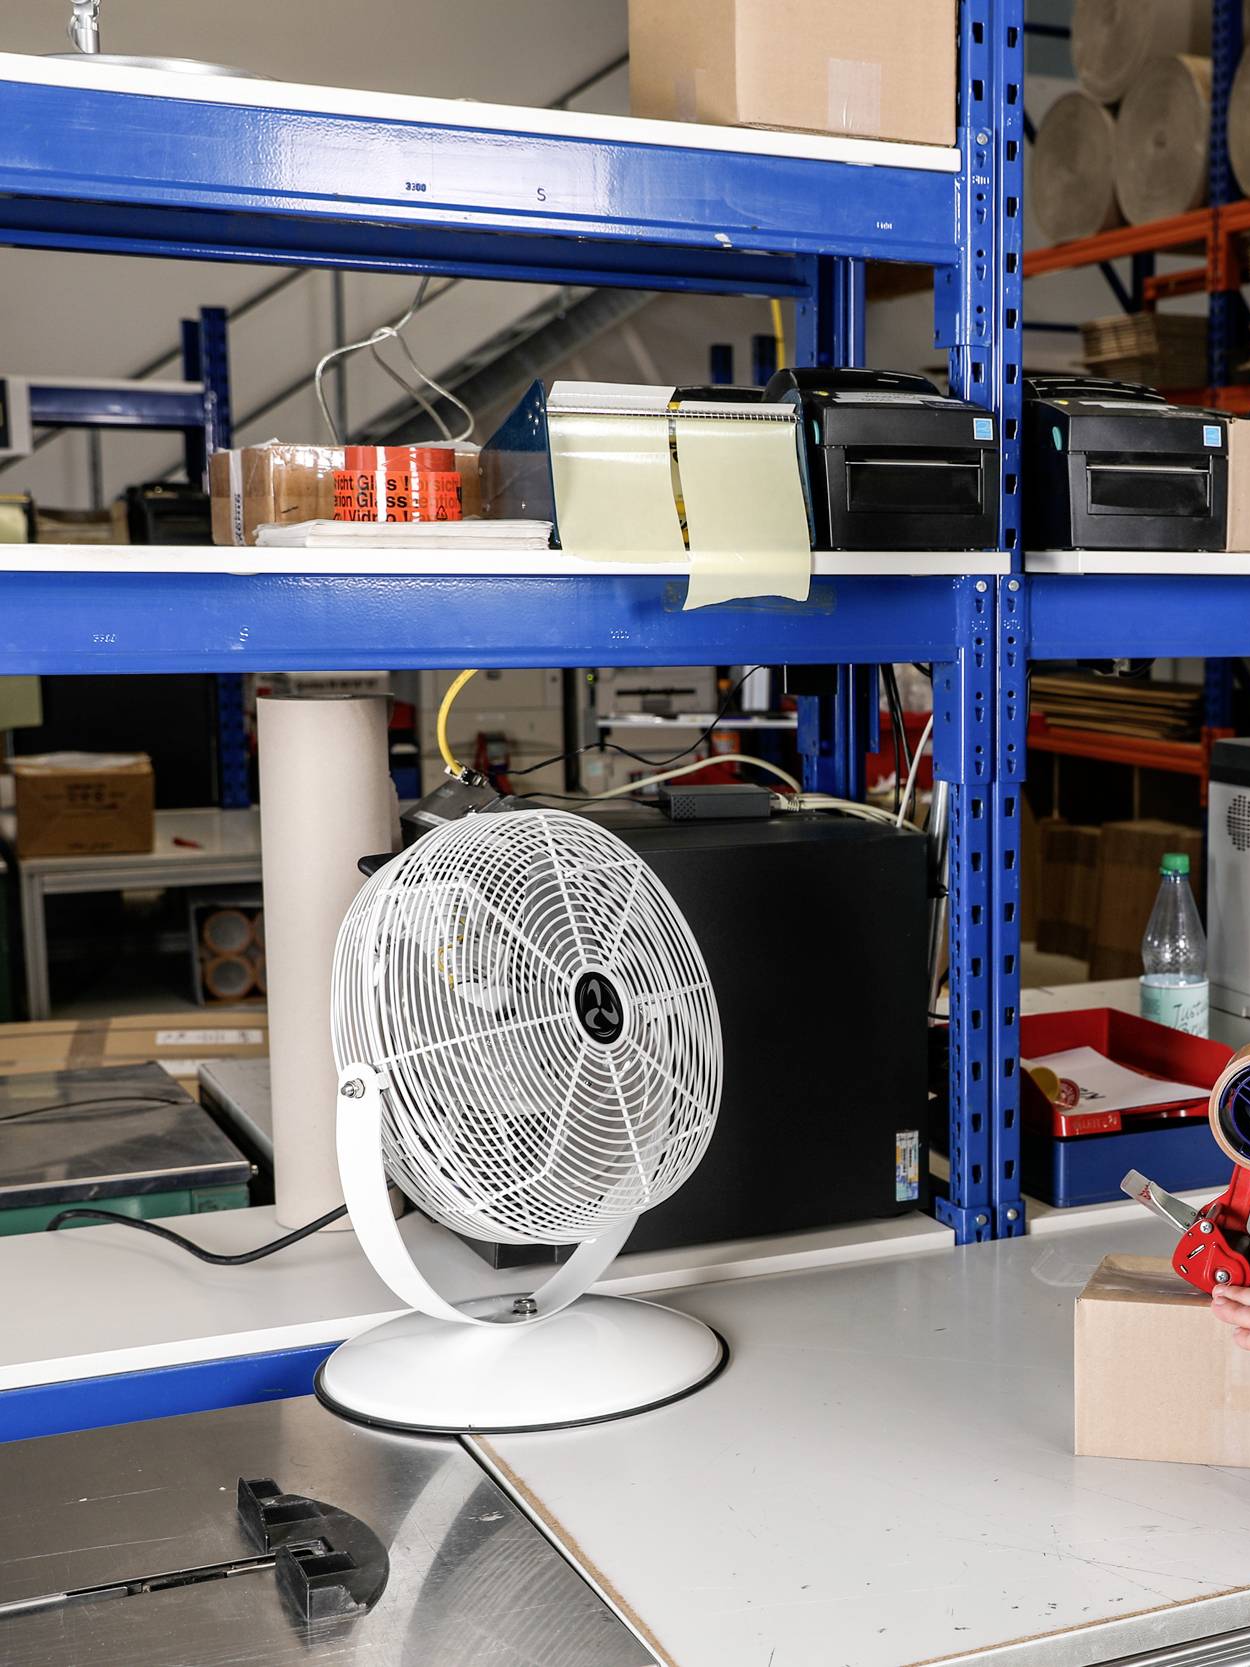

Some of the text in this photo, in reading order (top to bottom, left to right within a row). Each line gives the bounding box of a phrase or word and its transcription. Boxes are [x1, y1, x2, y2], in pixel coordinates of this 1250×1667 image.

[536, 187, 547, 202] S
[357, 474, 397, 491] Gls
[356, 491, 407, 508] Glss
